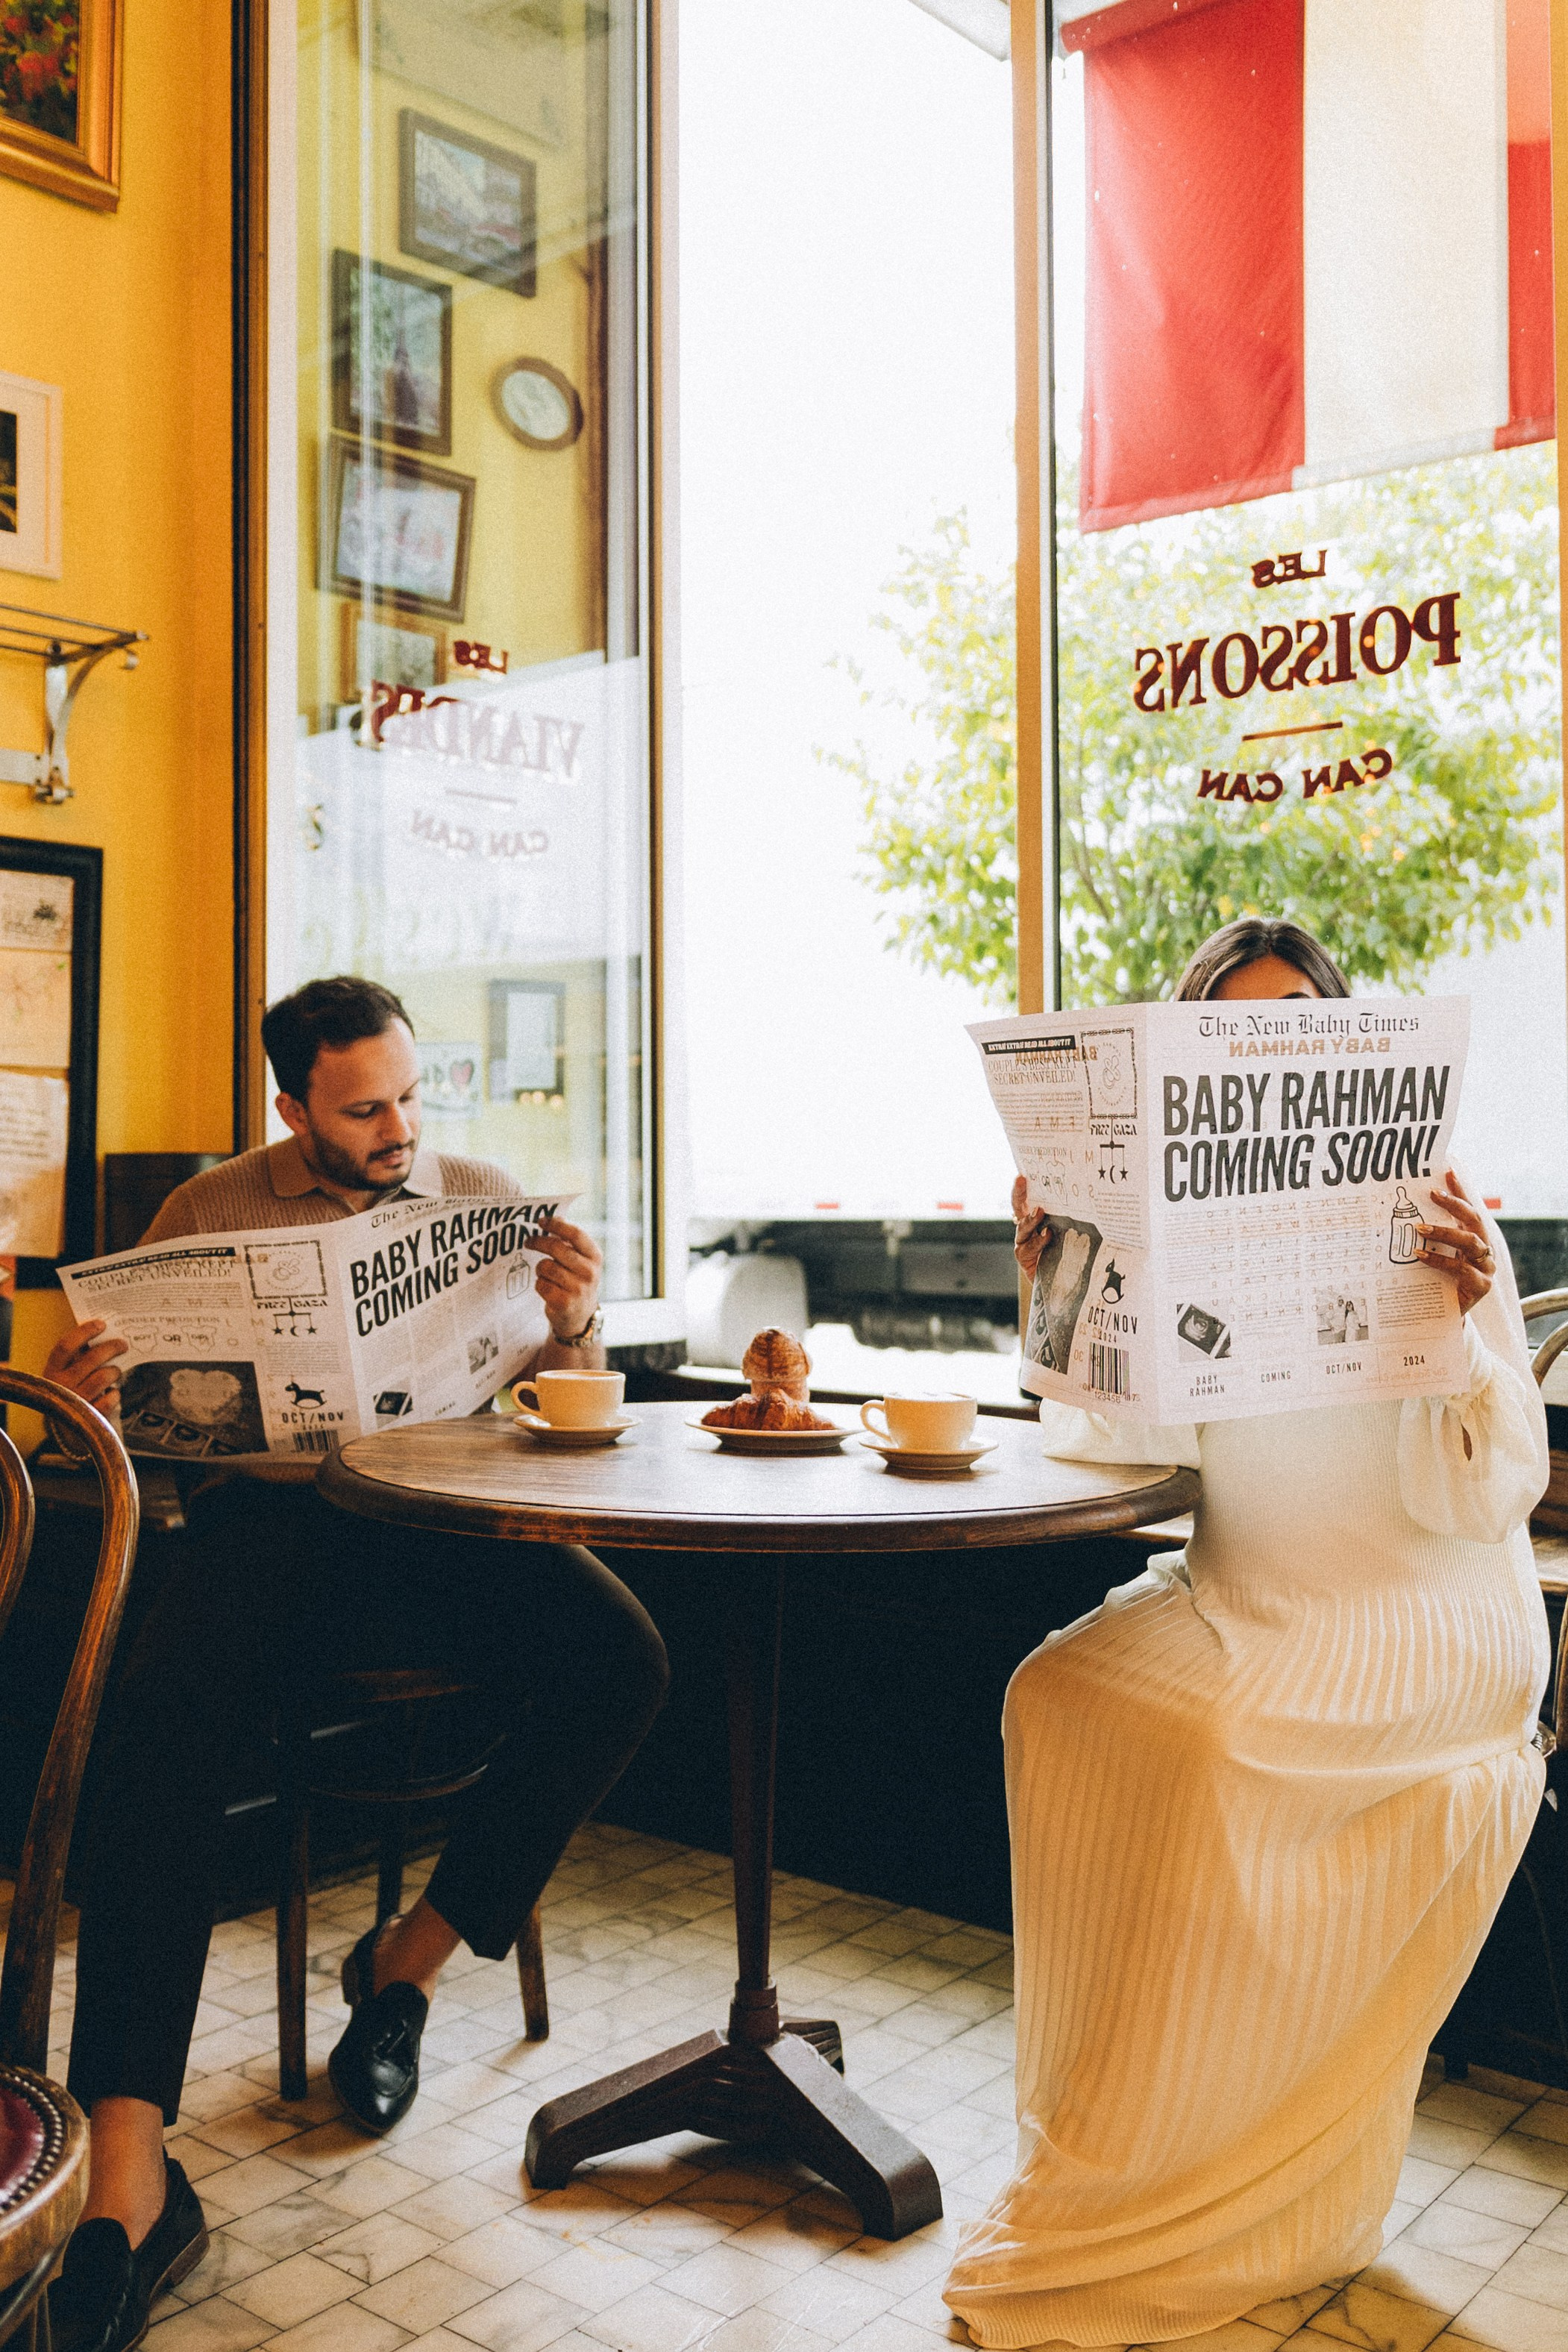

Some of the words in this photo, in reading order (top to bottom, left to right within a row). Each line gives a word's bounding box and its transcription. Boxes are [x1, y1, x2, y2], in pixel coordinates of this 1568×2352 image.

[1199, 1016, 1239, 1040] The
[1247, 1015, 1290, 1035] New
[1298, 1014, 1350, 1038] Baby
[1358, 1012, 1419, 1032] Times
[1163, 1073, 1271, 1135] BABY
[1281, 1065, 1450, 1130] RAHMAN
[1090, 1123, 1110, 1135] FREE
[1113, 1123, 1138, 1135] GAZA
[1164, 1134, 1315, 1202] COMING
[1322, 1125, 1440, 1187] SOON!
[371, 1209, 399, 1229] The
[404, 1201, 439, 1216] New
[350, 1229, 422, 1300] BABY
[430, 1202, 559, 1258] RAHMAN
[196, 1259, 234, 1269] KEPT
[88, 1275, 144, 1292] SECRET
[151, 1269, 231, 1280] UNVEILED!
[356, 1252, 459, 1337] COMING
[466, 1223, 549, 1274] SOON
[257, 1301, 286, 1309] FREE
[293, 1299, 328, 1308] GAZA
[1088, 1305, 1138, 1334] OCT/NOV
[162, 1334, 182, 1343] OR
[1098, 1331, 1117, 1343] 2024
[1403, 1355, 1425, 1367] 2024
[1326, 1362, 1362, 1375] OCT/NOV
[1196, 1375, 1218, 1385] BABY
[1261, 1371, 1291, 1383] COMING
[1189, 1385, 1225, 1397] RAHMAN
[281, 1411, 344, 1423] OCT/NOV
